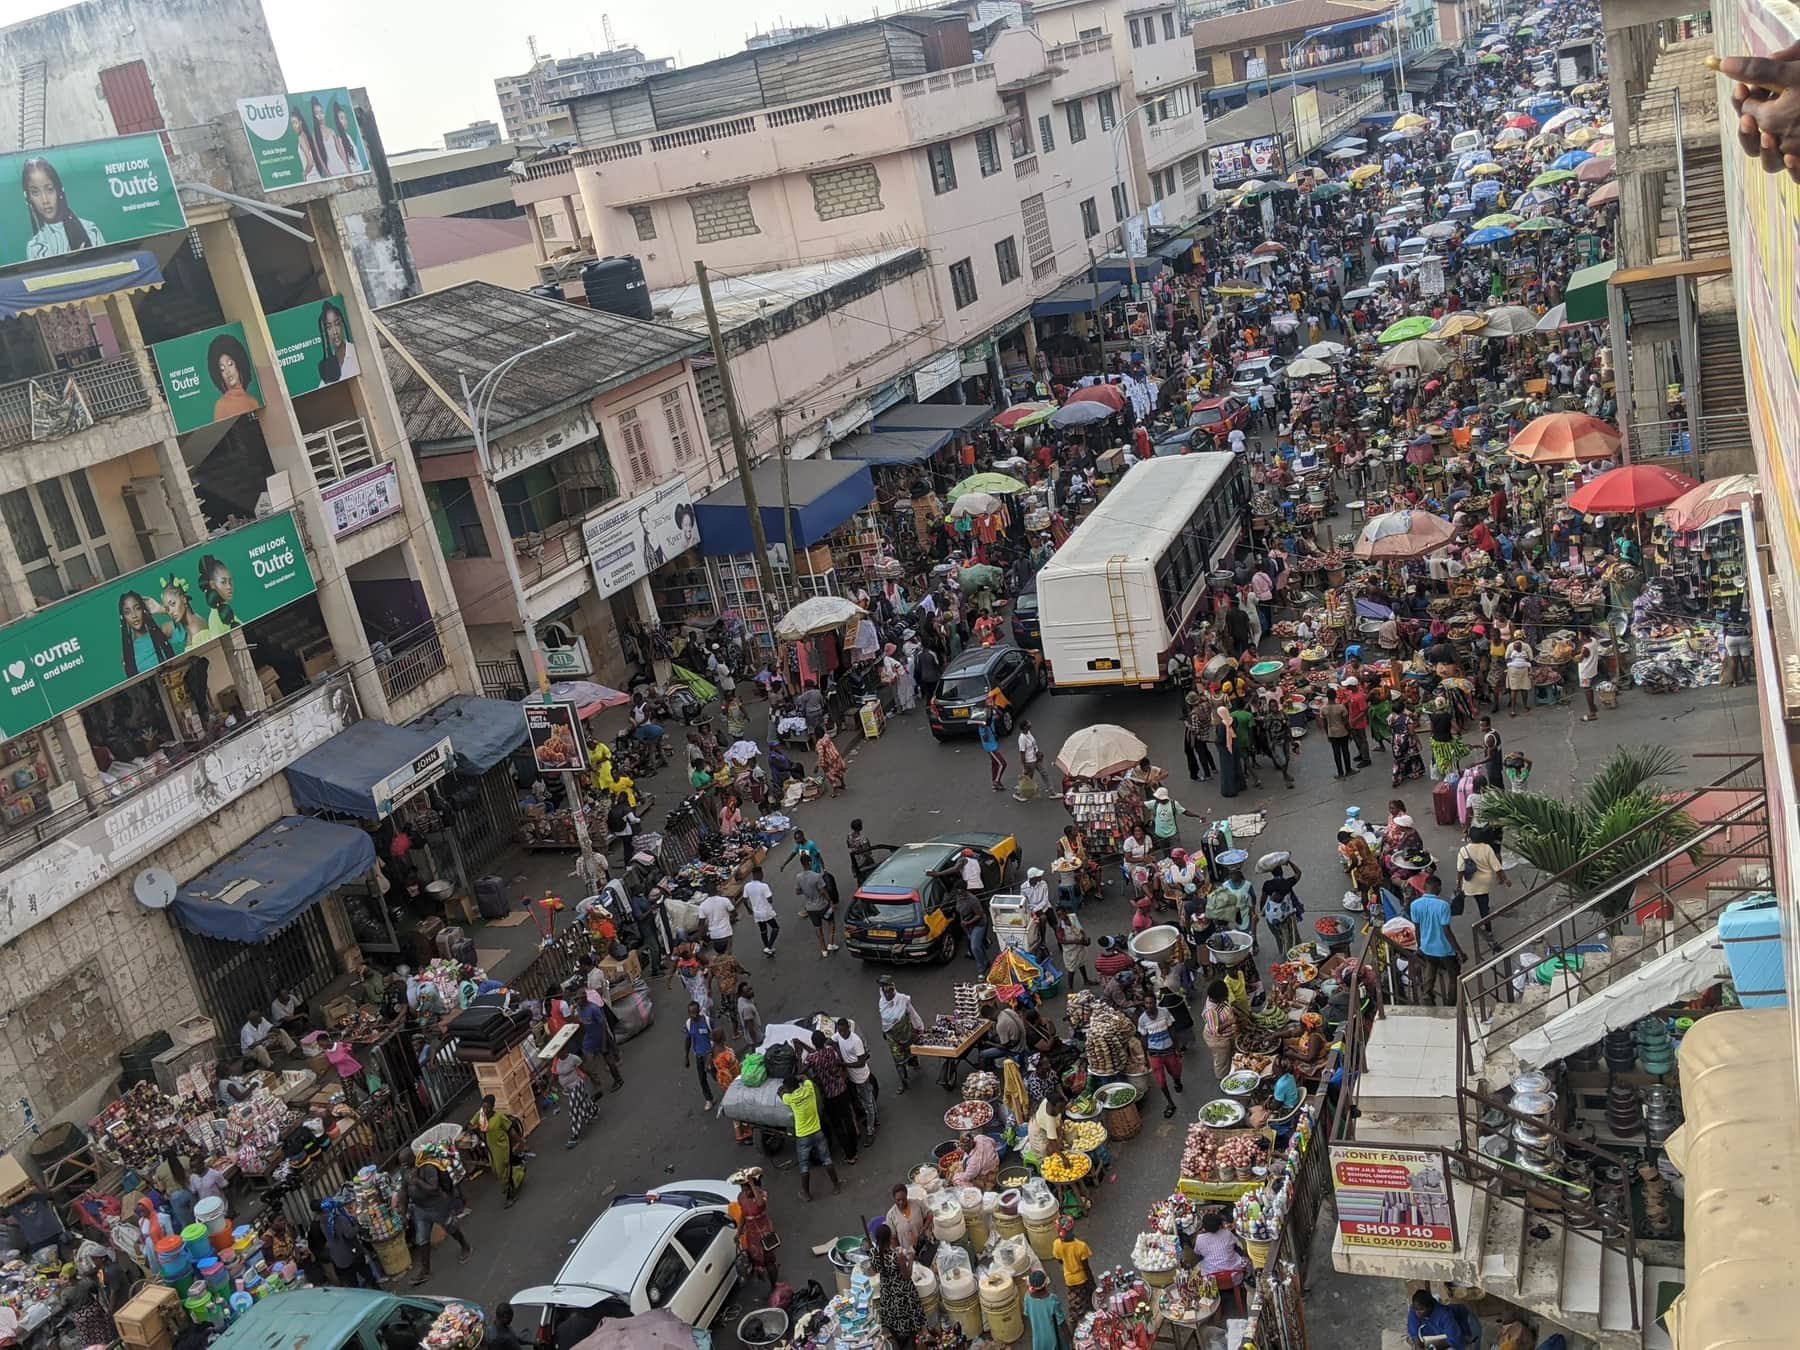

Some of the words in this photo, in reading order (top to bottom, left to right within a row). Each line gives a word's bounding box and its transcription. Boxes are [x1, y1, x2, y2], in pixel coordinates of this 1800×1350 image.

[245, 99, 284, 121] Outré
[105, 161, 125, 175] NEW
[126, 158, 149, 171] LOOK
[108, 171, 158, 198] Outré
[169, 369, 182, 378] NEW
[182, 366, 195, 375] LOOK
[171, 374, 200, 392] Outré
[249, 544, 266, 559] NEW
[266, 536, 286, 551] LOOK
[252, 546, 294, 578] Outré
[2, 669, 10, 683] I
[11, 678, 35, 696] Braid
[43, 666, 60, 680] and
[60, 655, 84, 672] More!
[416, 751, 436, 770] JOHN
[104, 798, 144, 838] GIFT
[146, 775, 188, 813] HAIR
[1333, 1150, 1379, 1160] AKONIT
[1381, 1152, 1434, 1163] FABRICS
[1356, 1224, 1401, 1236] SHOP
[1404, 1226, 1433, 1238] 140
[1346, 1235, 1370, 1244] TEL:
[1374, 1238, 1447, 1250] 0249703900
